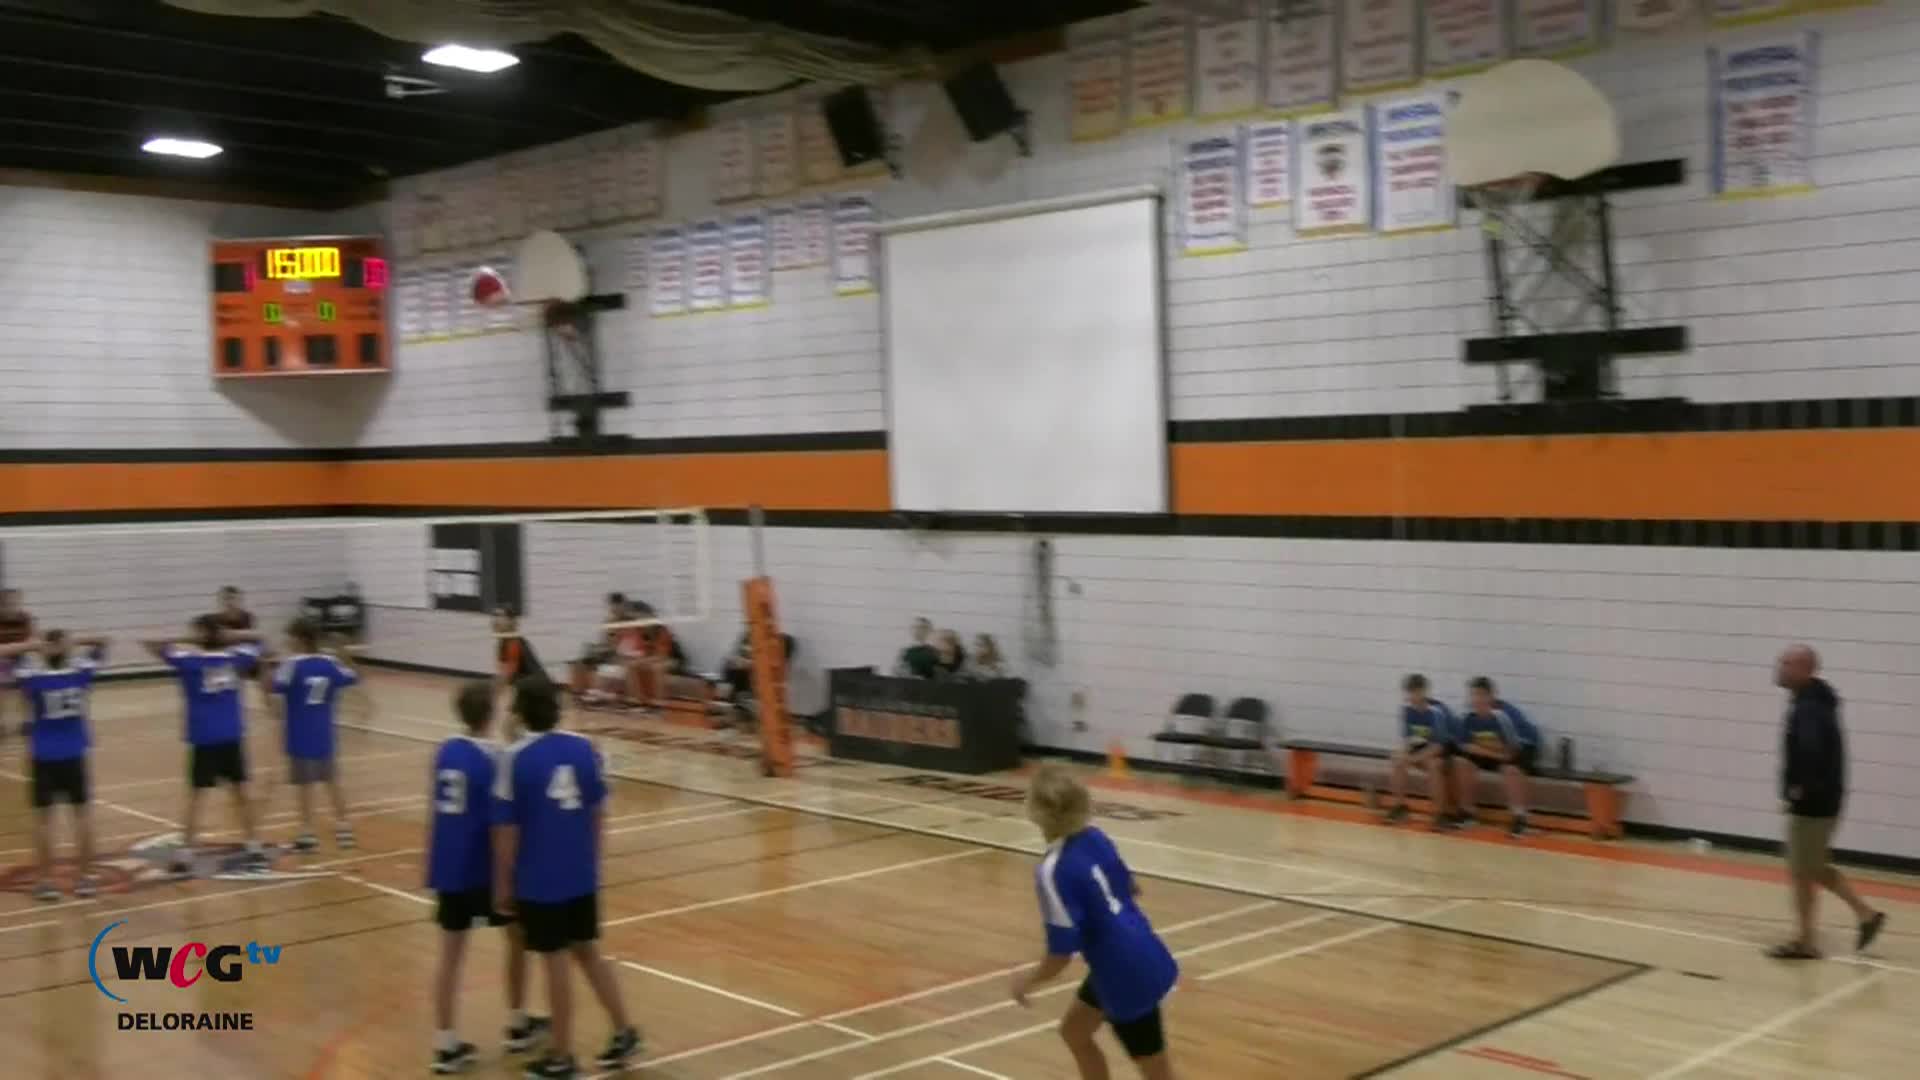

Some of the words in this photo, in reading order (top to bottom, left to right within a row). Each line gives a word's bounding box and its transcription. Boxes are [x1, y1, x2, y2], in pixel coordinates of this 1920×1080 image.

[304, 677, 329, 705] 7
[437, 768, 467, 814] 3
[545, 764, 583, 810] 4
[1091, 863, 1121, 915] 1
